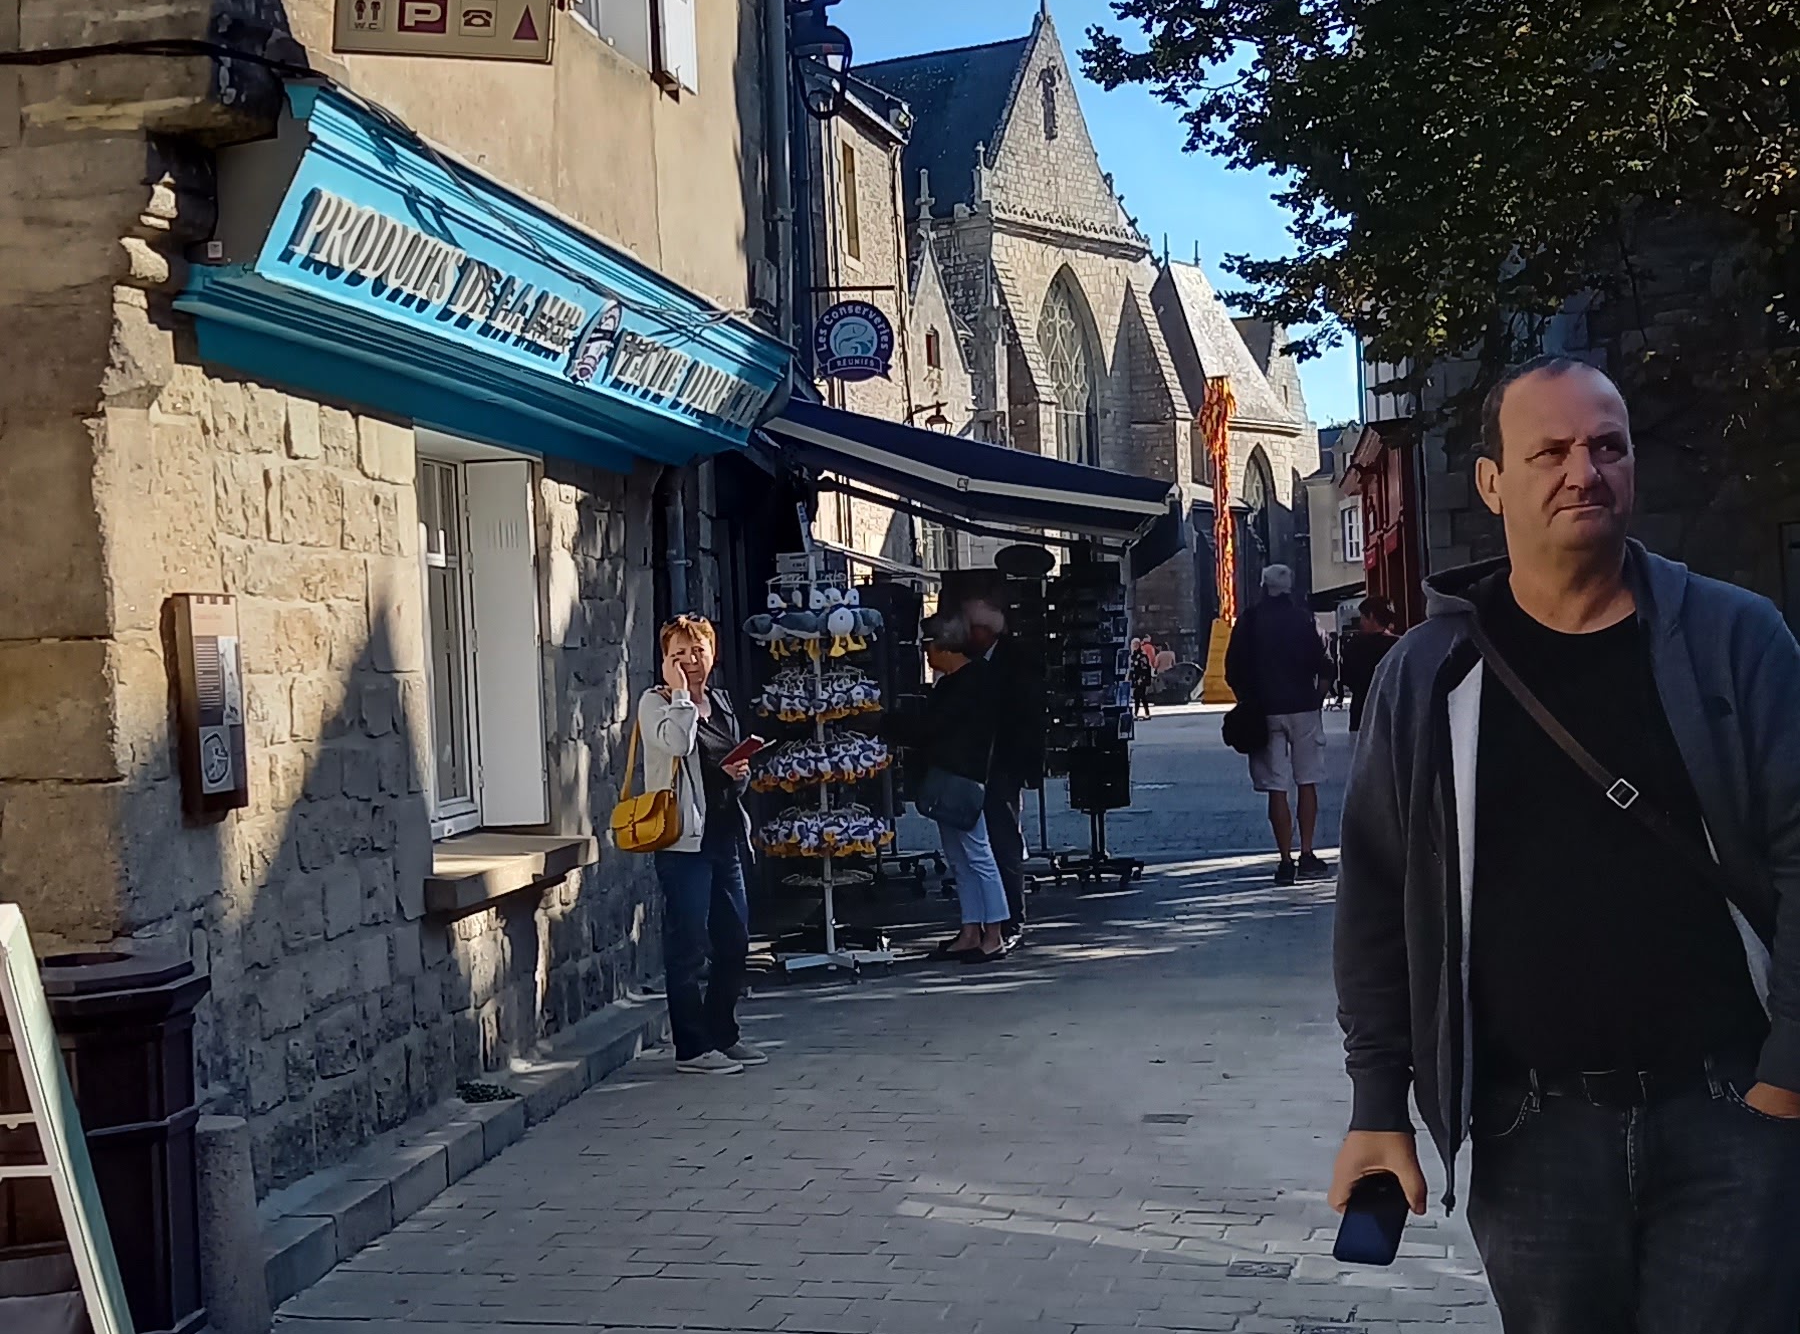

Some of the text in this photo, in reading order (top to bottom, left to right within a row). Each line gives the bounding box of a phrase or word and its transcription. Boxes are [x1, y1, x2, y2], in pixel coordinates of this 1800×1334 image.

[404, 1, 442, 26] P
[284, 188, 468, 306] PRODUITS
[448, 257, 503, 323] DE
[817, 305, 890, 352] Les Conserveries
